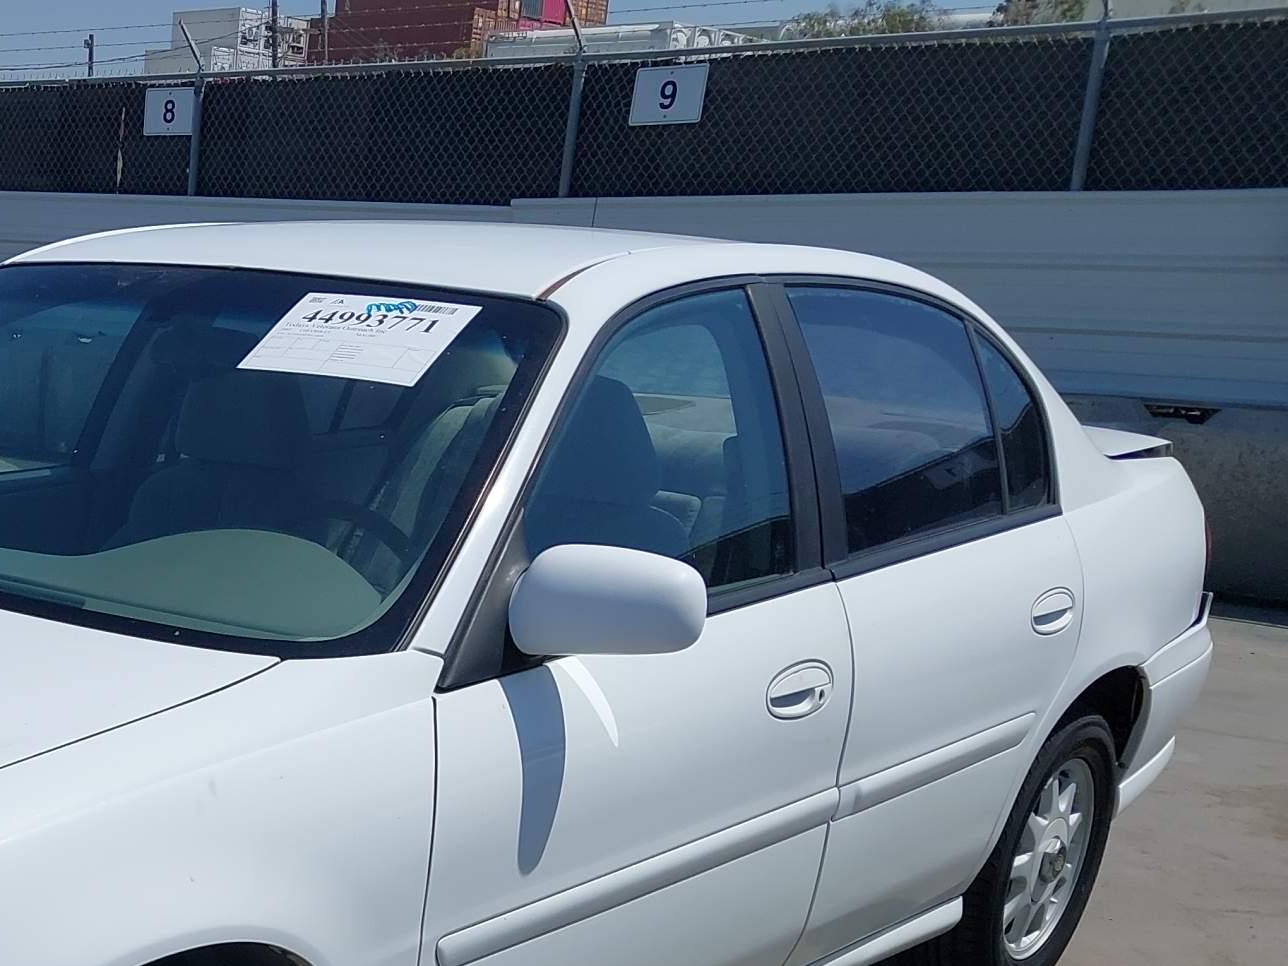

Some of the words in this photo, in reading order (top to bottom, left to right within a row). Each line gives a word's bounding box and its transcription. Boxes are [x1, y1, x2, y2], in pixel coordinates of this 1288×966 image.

[659, 79, 678, 110] 9
[163, 99, 176, 124] 8
[301, 309, 440, 333] 44993771
